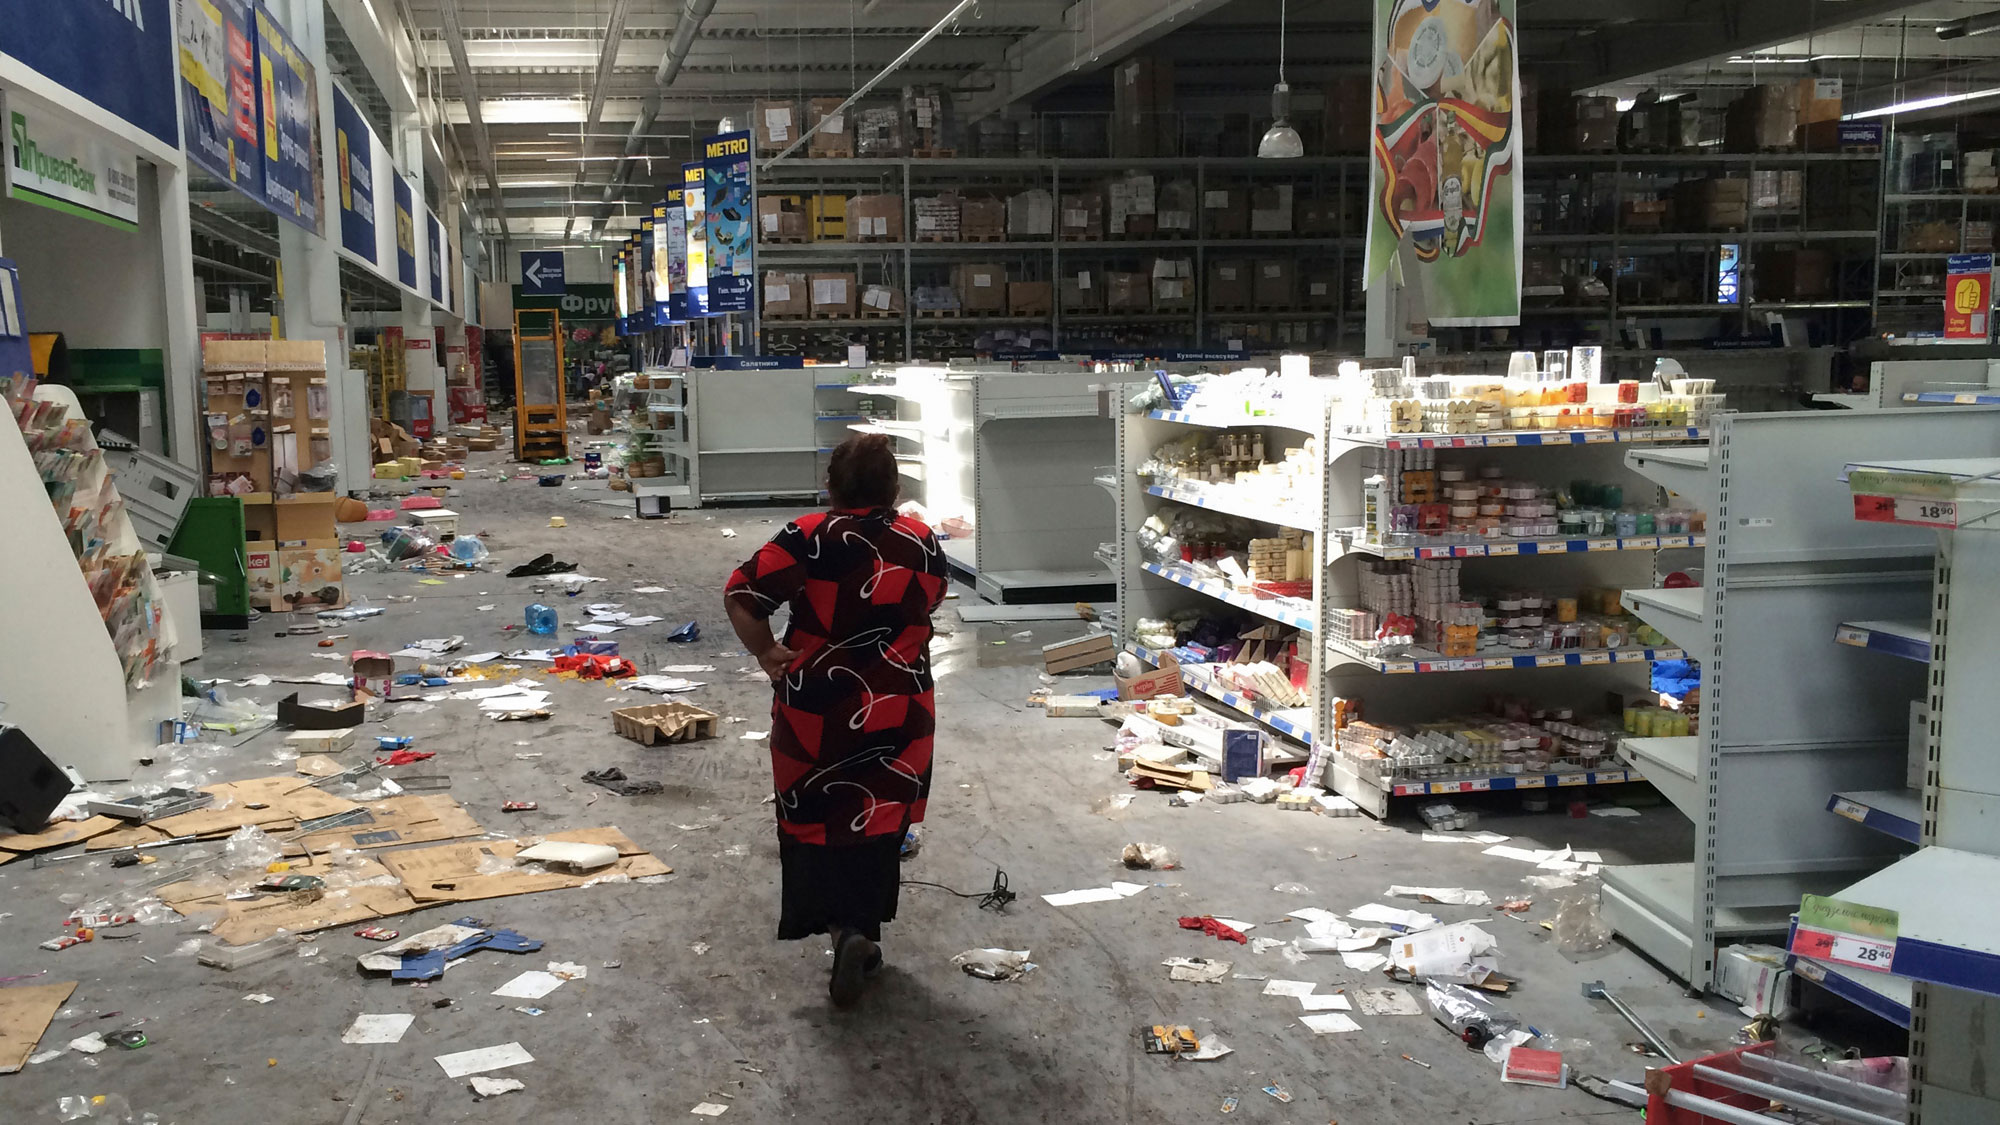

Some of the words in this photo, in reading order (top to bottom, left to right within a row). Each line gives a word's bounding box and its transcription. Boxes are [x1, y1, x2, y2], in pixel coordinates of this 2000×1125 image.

[706, 138, 748, 158] METRO
[685, 168, 704, 182] MET
[668, 189, 683, 201] ME
[653, 207, 666, 218] ME
[642, 221, 653, 231] ME
[561, 294, 615, 314] Фру
[248, 555, 268, 567] ker
